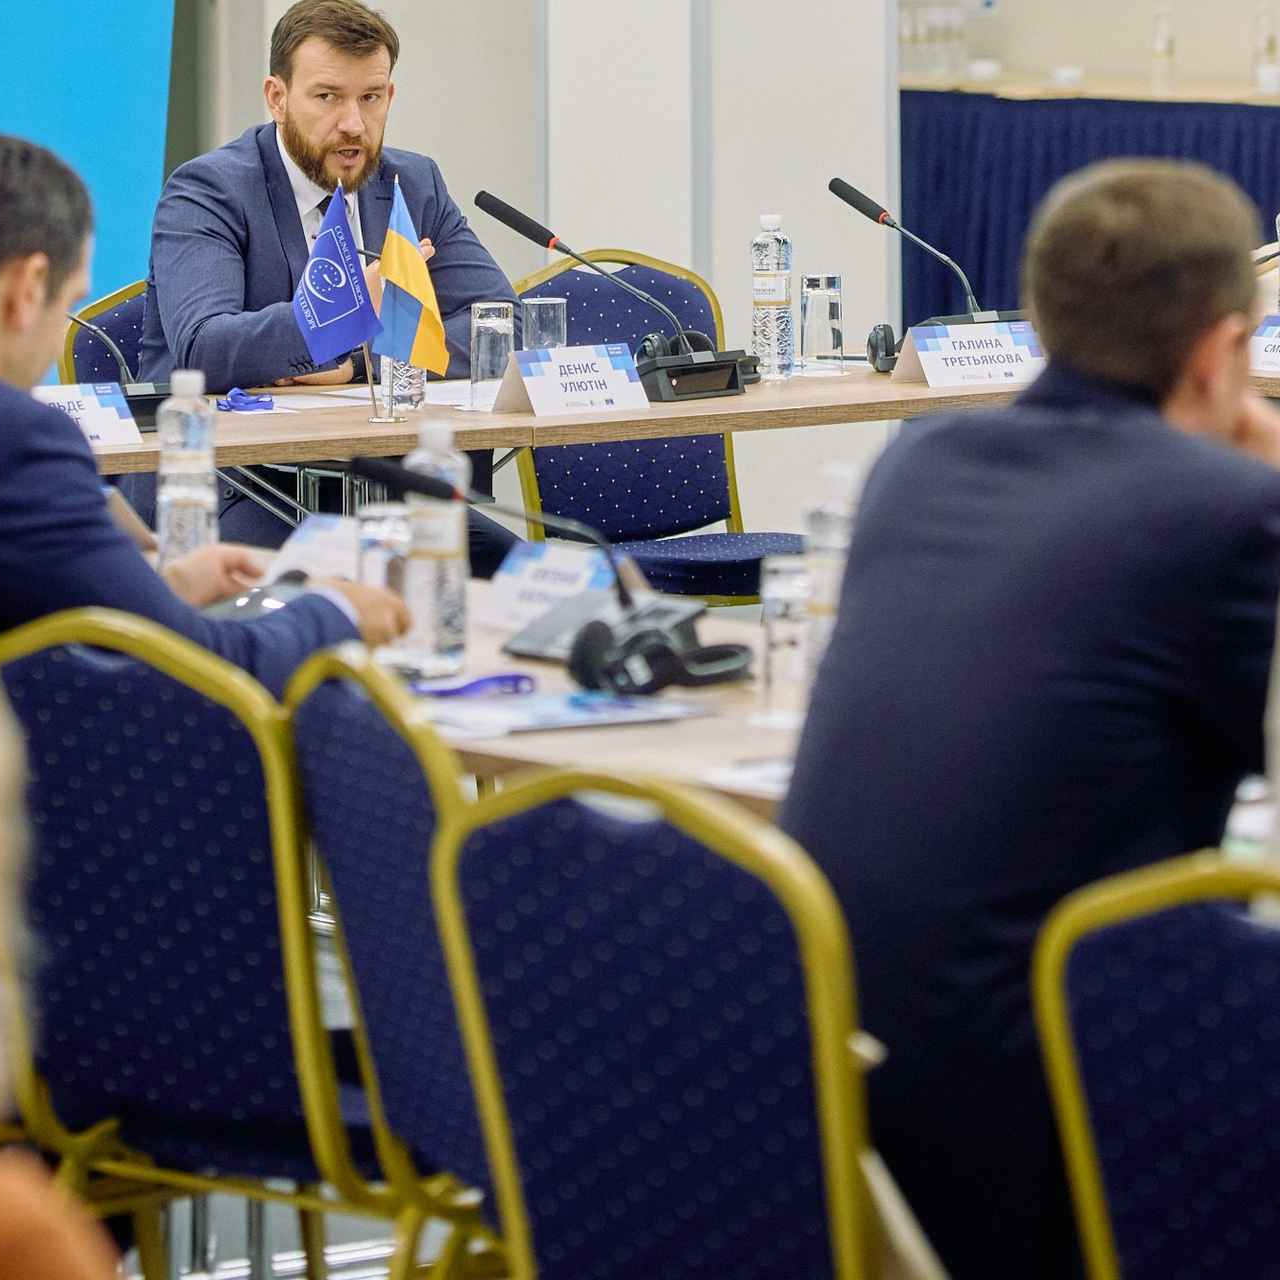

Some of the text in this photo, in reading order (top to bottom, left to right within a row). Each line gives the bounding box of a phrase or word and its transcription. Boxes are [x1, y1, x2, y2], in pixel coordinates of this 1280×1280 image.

[951, 338, 1004, 351] ГАЛИНА
[942, 353, 1024, 367] ТРЕТЬЯКОВА
[560, 363, 599, 377] ДЕНИС
[561, 380, 607, 392] УЛЮТІН
